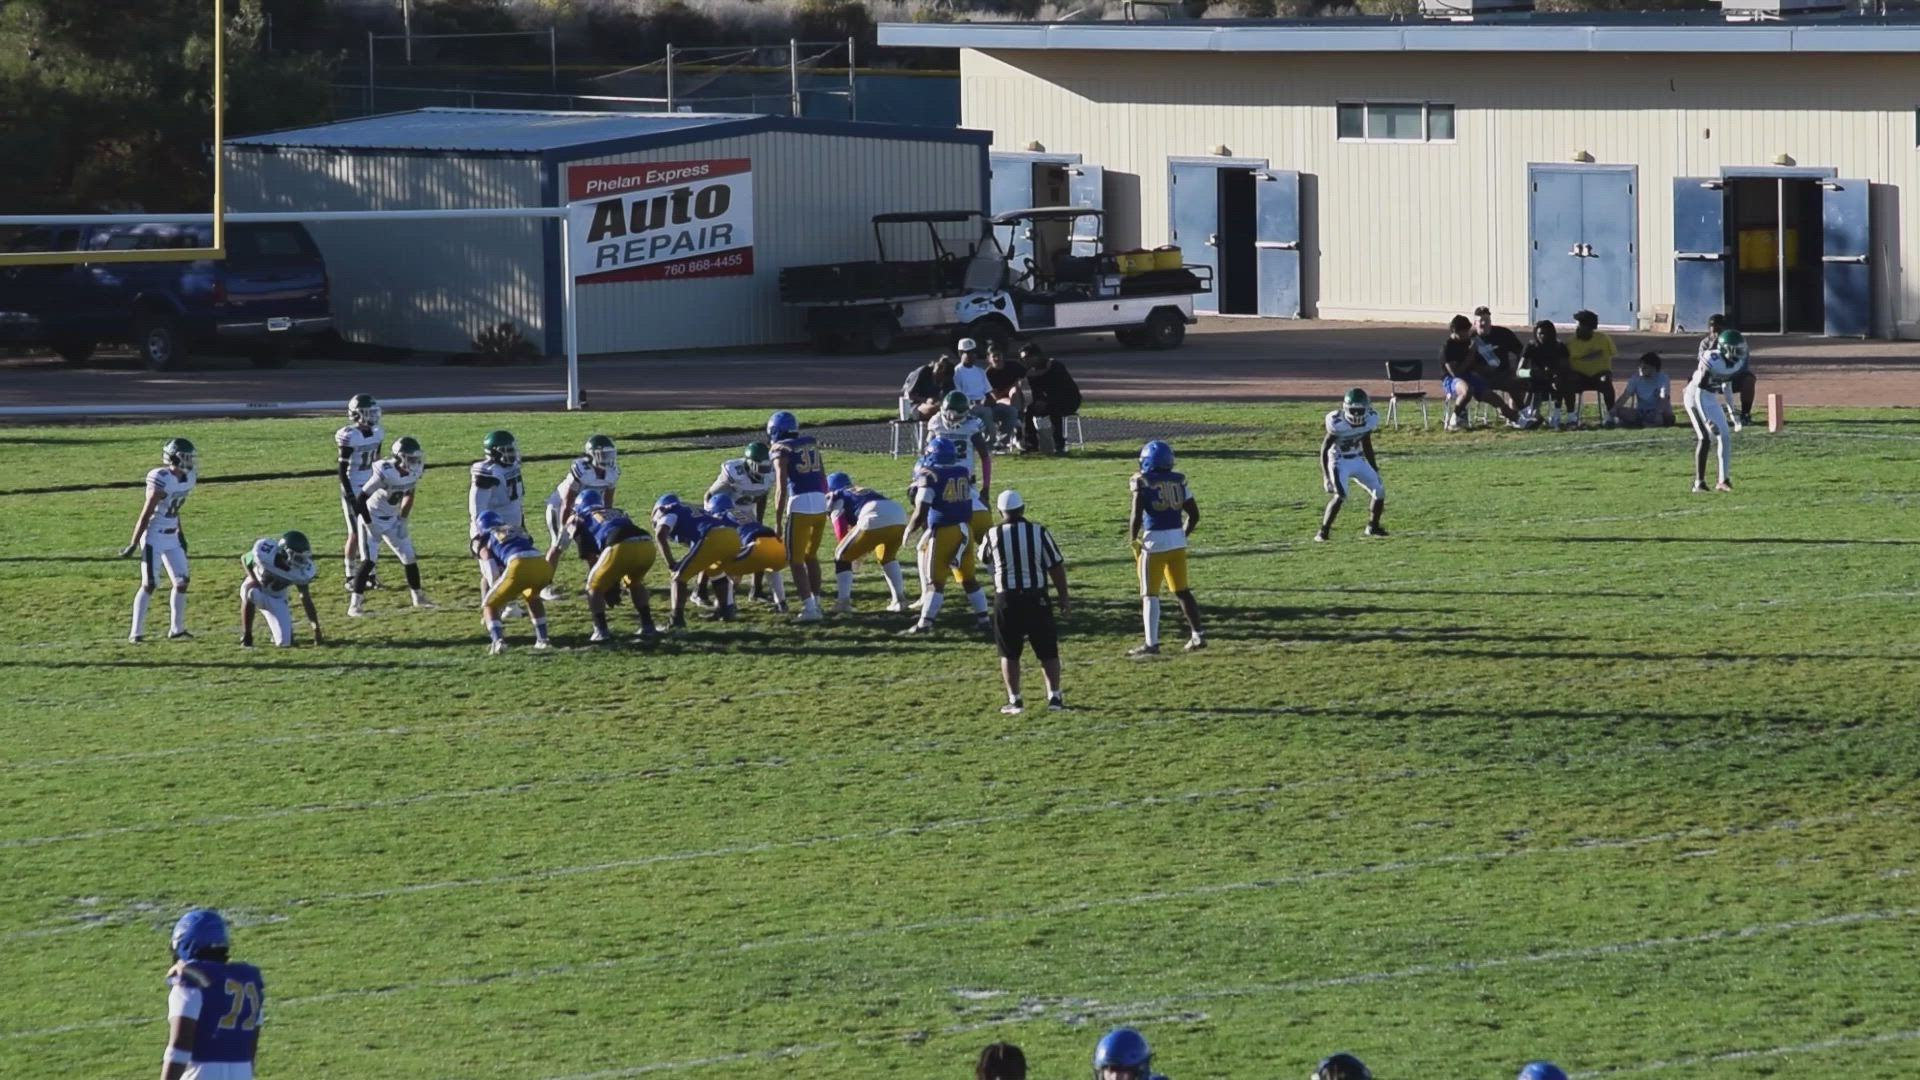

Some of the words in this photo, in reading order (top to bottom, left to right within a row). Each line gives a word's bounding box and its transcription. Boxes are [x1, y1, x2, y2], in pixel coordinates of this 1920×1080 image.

[586, 175, 641, 194] Phelan
[645, 164, 710, 184] Express
[586, 183, 731, 244] Auto
[595, 222, 734, 269] REPAIR
[664, 262, 686, 277] 760
[942, 477, 969, 502] 40
[1150, 481, 1184, 511] 30
